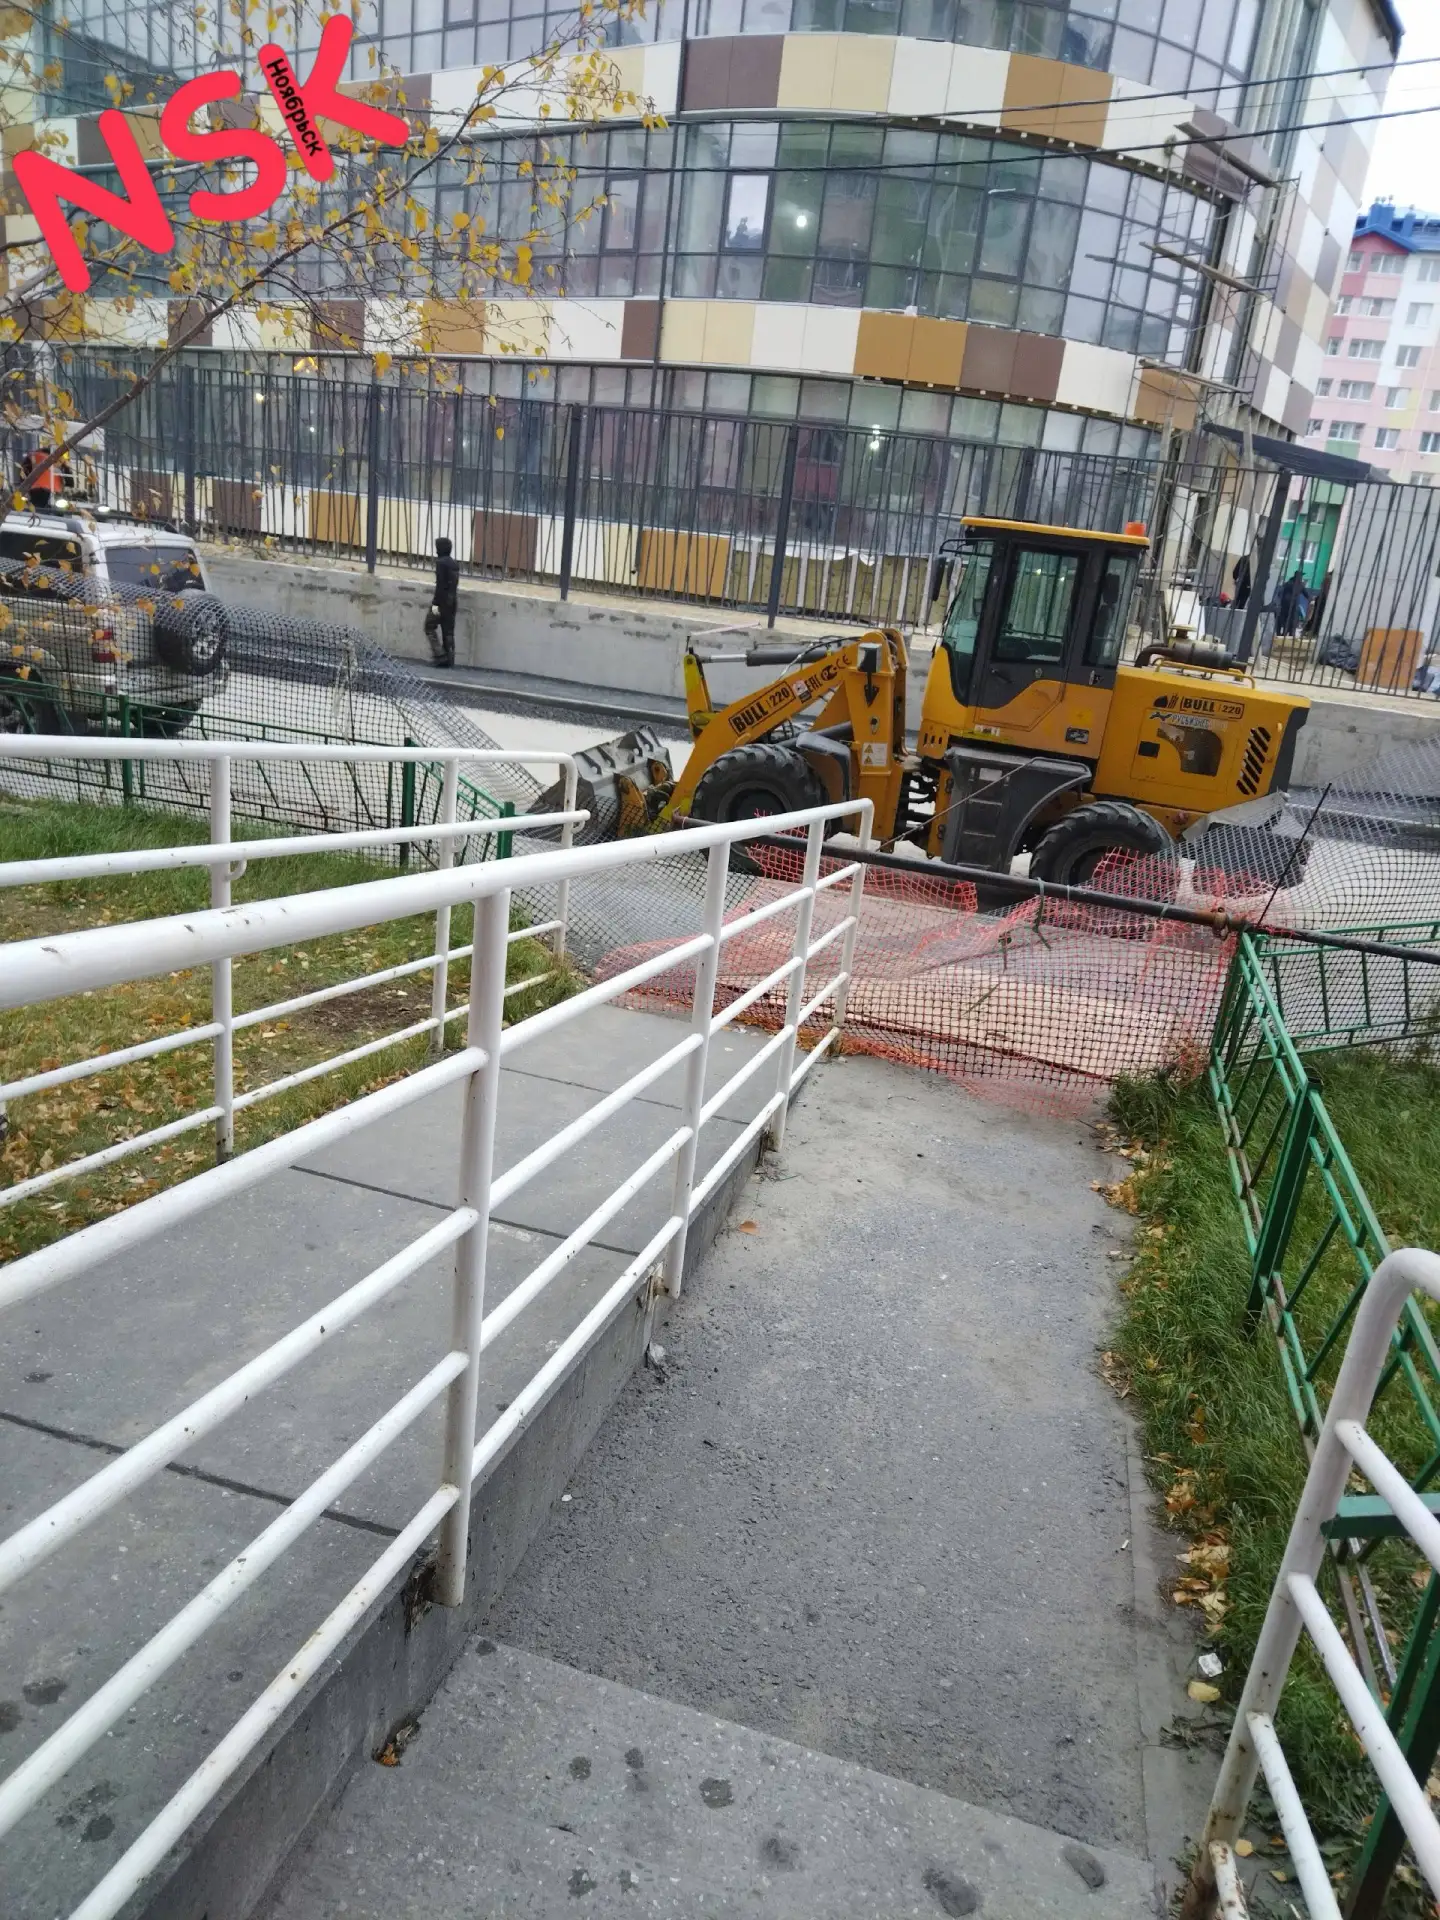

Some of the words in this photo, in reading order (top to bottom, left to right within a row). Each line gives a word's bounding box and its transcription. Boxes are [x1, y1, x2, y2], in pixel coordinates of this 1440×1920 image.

[731, 702, 769, 733] BULL
[768, 687, 790, 707] 220
[1183, 698, 1215, 712] BULL
[1222, 705, 1241, 714] 220
